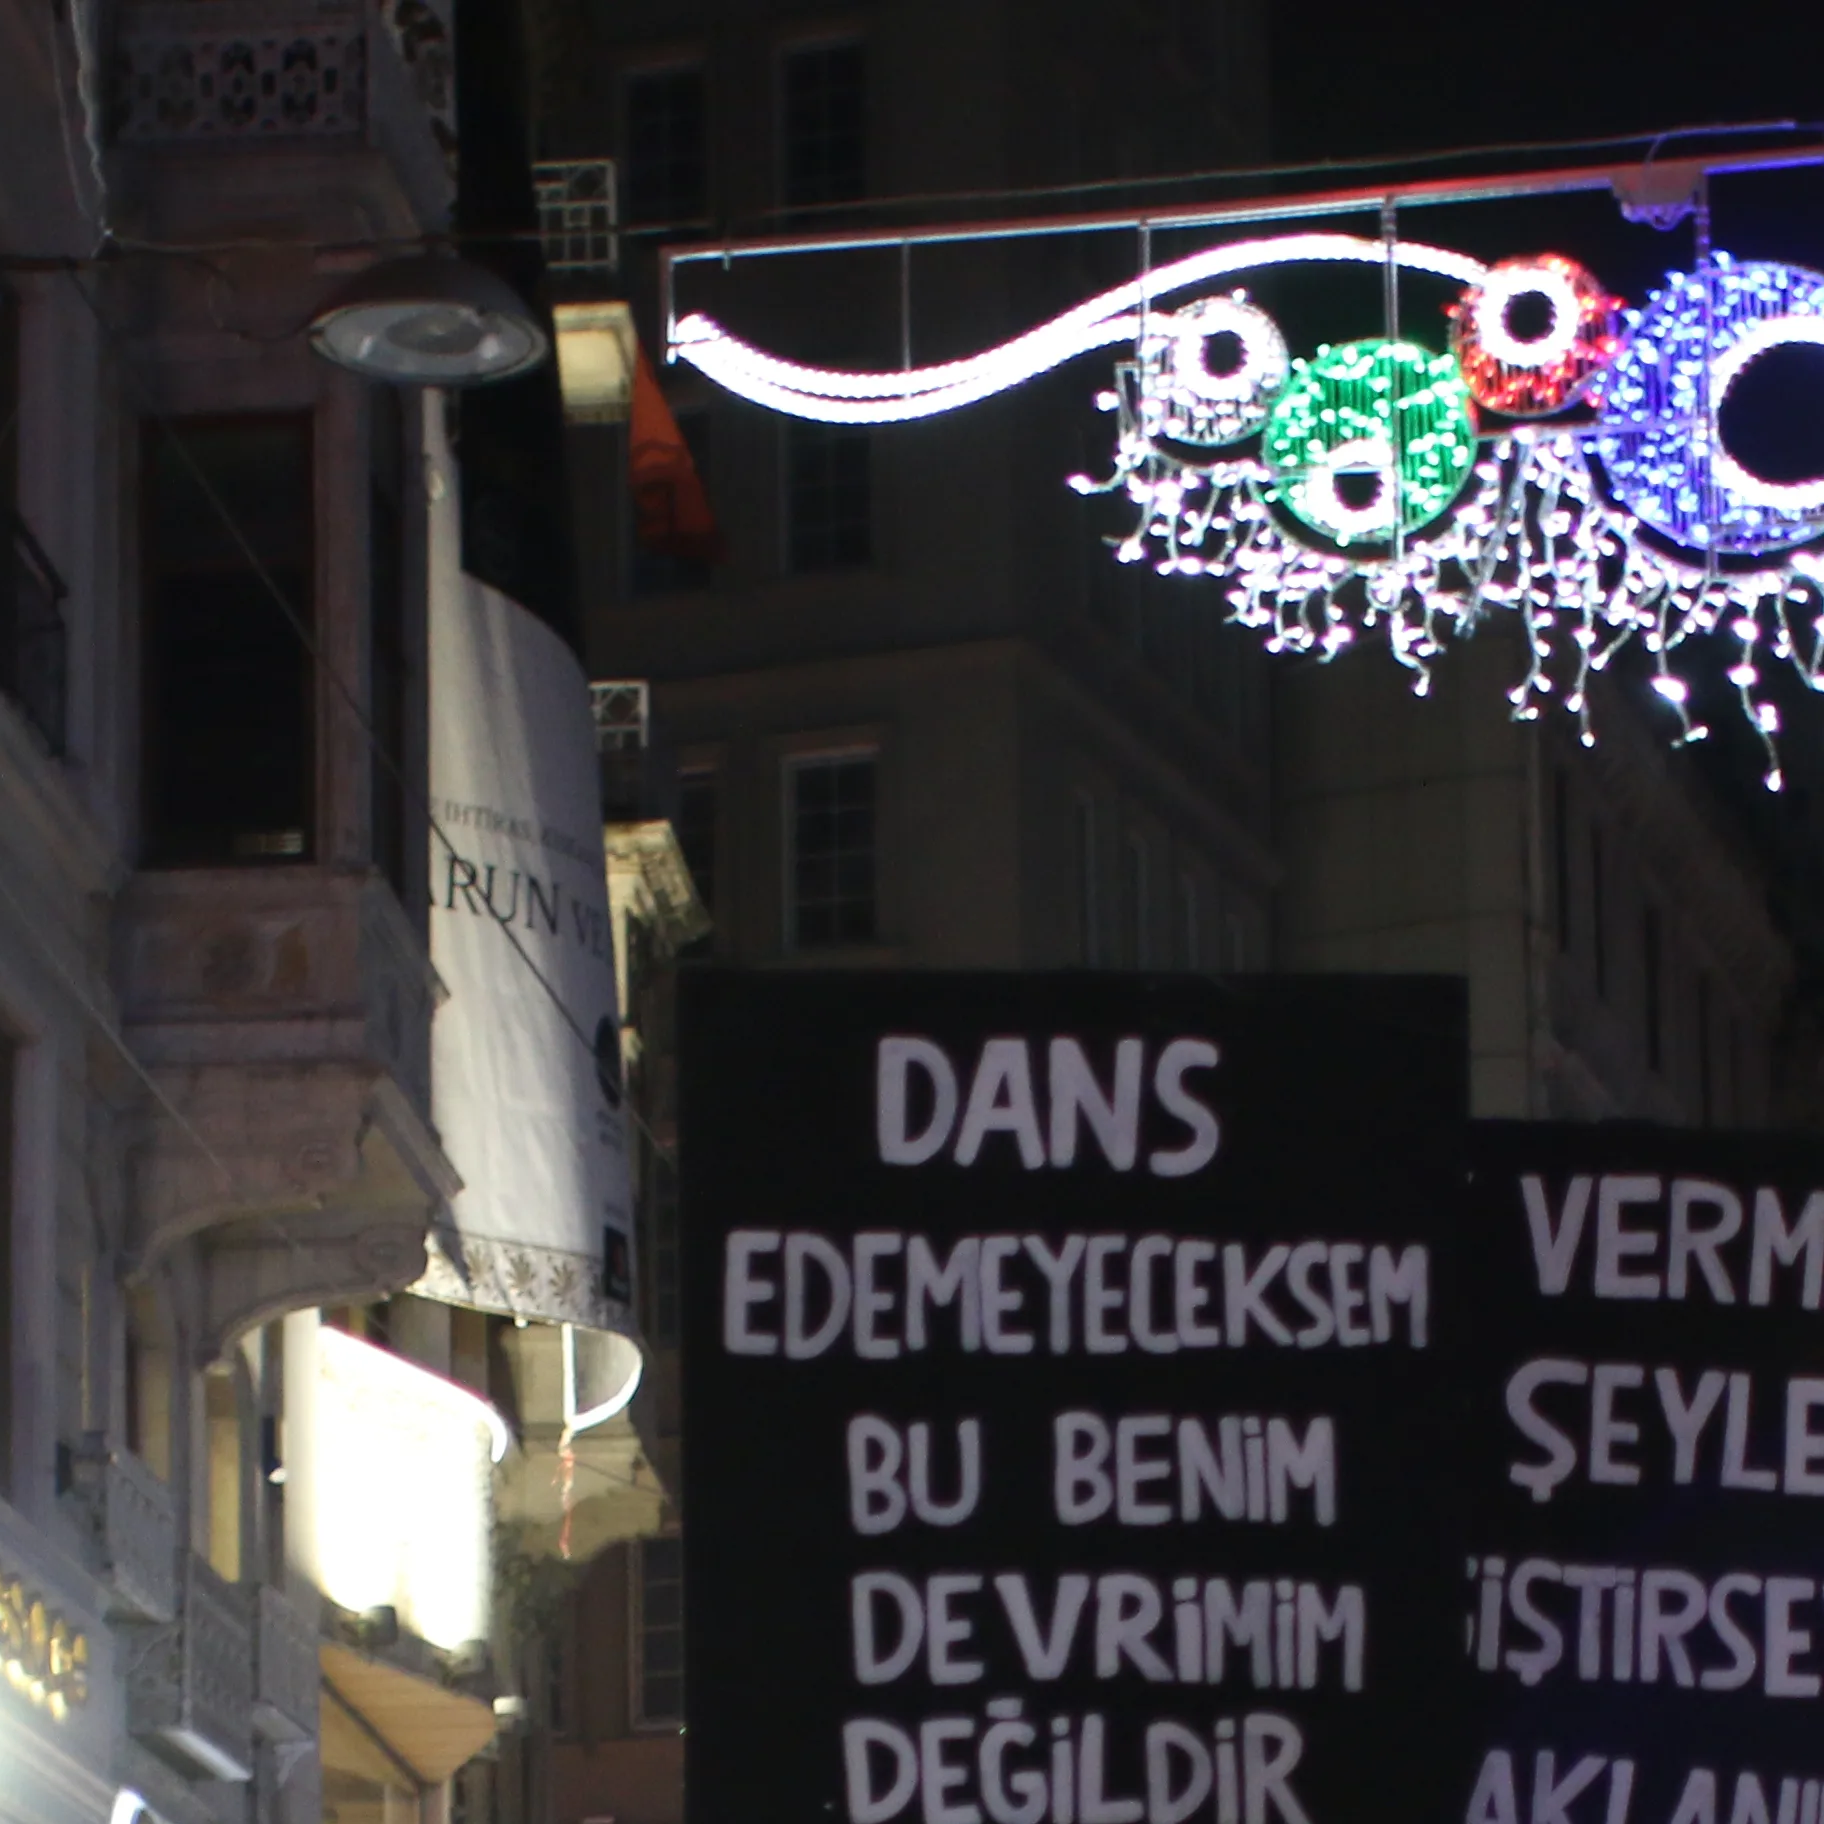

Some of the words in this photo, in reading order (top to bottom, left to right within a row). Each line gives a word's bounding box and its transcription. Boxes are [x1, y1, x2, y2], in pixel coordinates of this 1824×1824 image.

[876, 1036, 1220, 1178] DANS
[723, 1229, 1429, 1360] EDEMEYECEKSEM
[846, 1414, 982, 1535] BU
